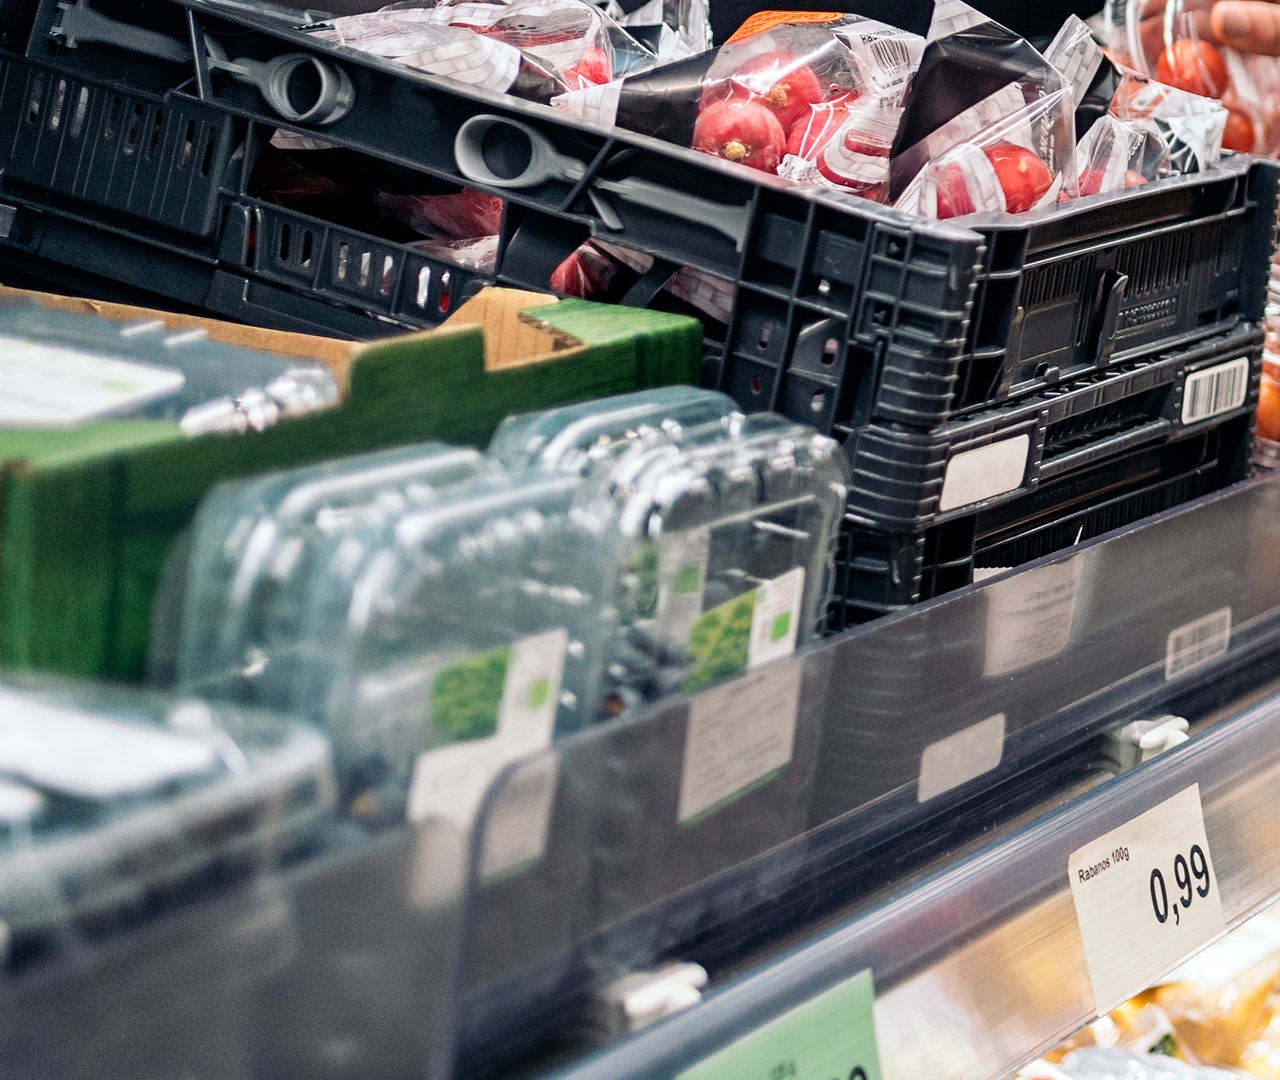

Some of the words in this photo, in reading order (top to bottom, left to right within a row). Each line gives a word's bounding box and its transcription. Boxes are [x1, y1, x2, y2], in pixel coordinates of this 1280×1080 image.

[1078, 857, 1111, 884] Rabanos
[1111, 846, 1130, 865] 100g
[1150, 844, 1210, 926] 0,99
